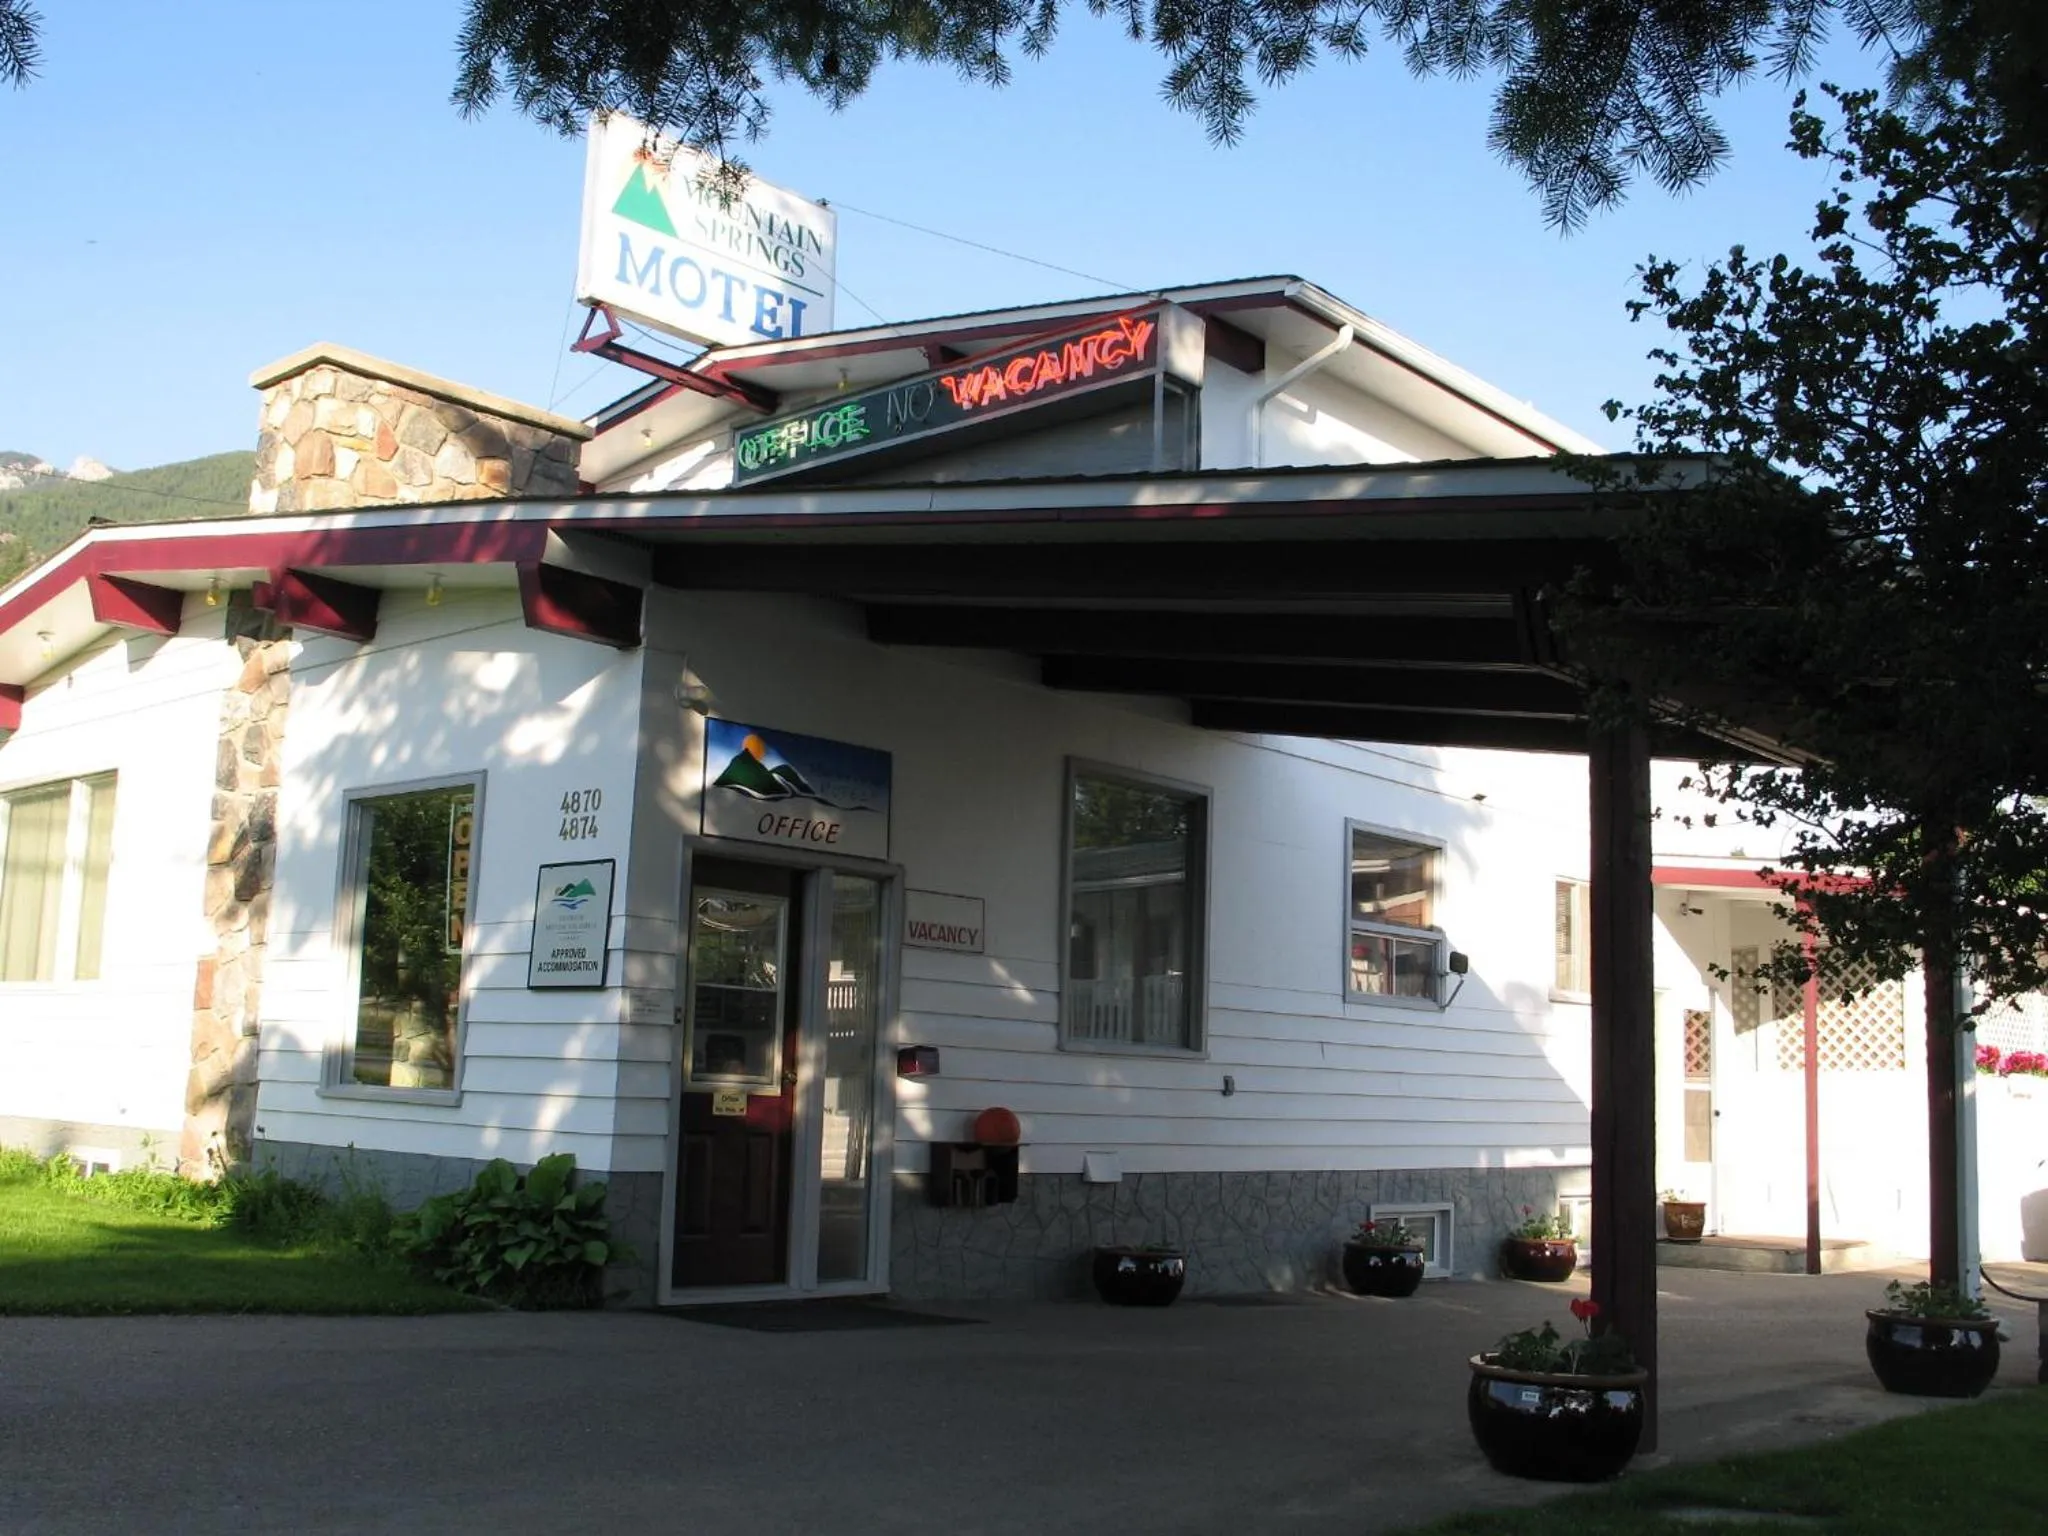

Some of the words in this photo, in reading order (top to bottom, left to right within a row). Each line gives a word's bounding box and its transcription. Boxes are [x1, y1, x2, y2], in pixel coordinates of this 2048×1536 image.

[695, 215, 805, 278] SPRINGS
[738, 404, 871, 469] OFFICE
[886, 388, 936, 426] NO
[940, 316, 1155, 409] VACANCY
[560, 788, 601, 814] 4870
[559, 815, 598, 840] 4874
[757, 813, 840, 844] OFFICE
[908, 920, 979, 945] VACANCY
[551, 947, 587, 959] APPROVED
